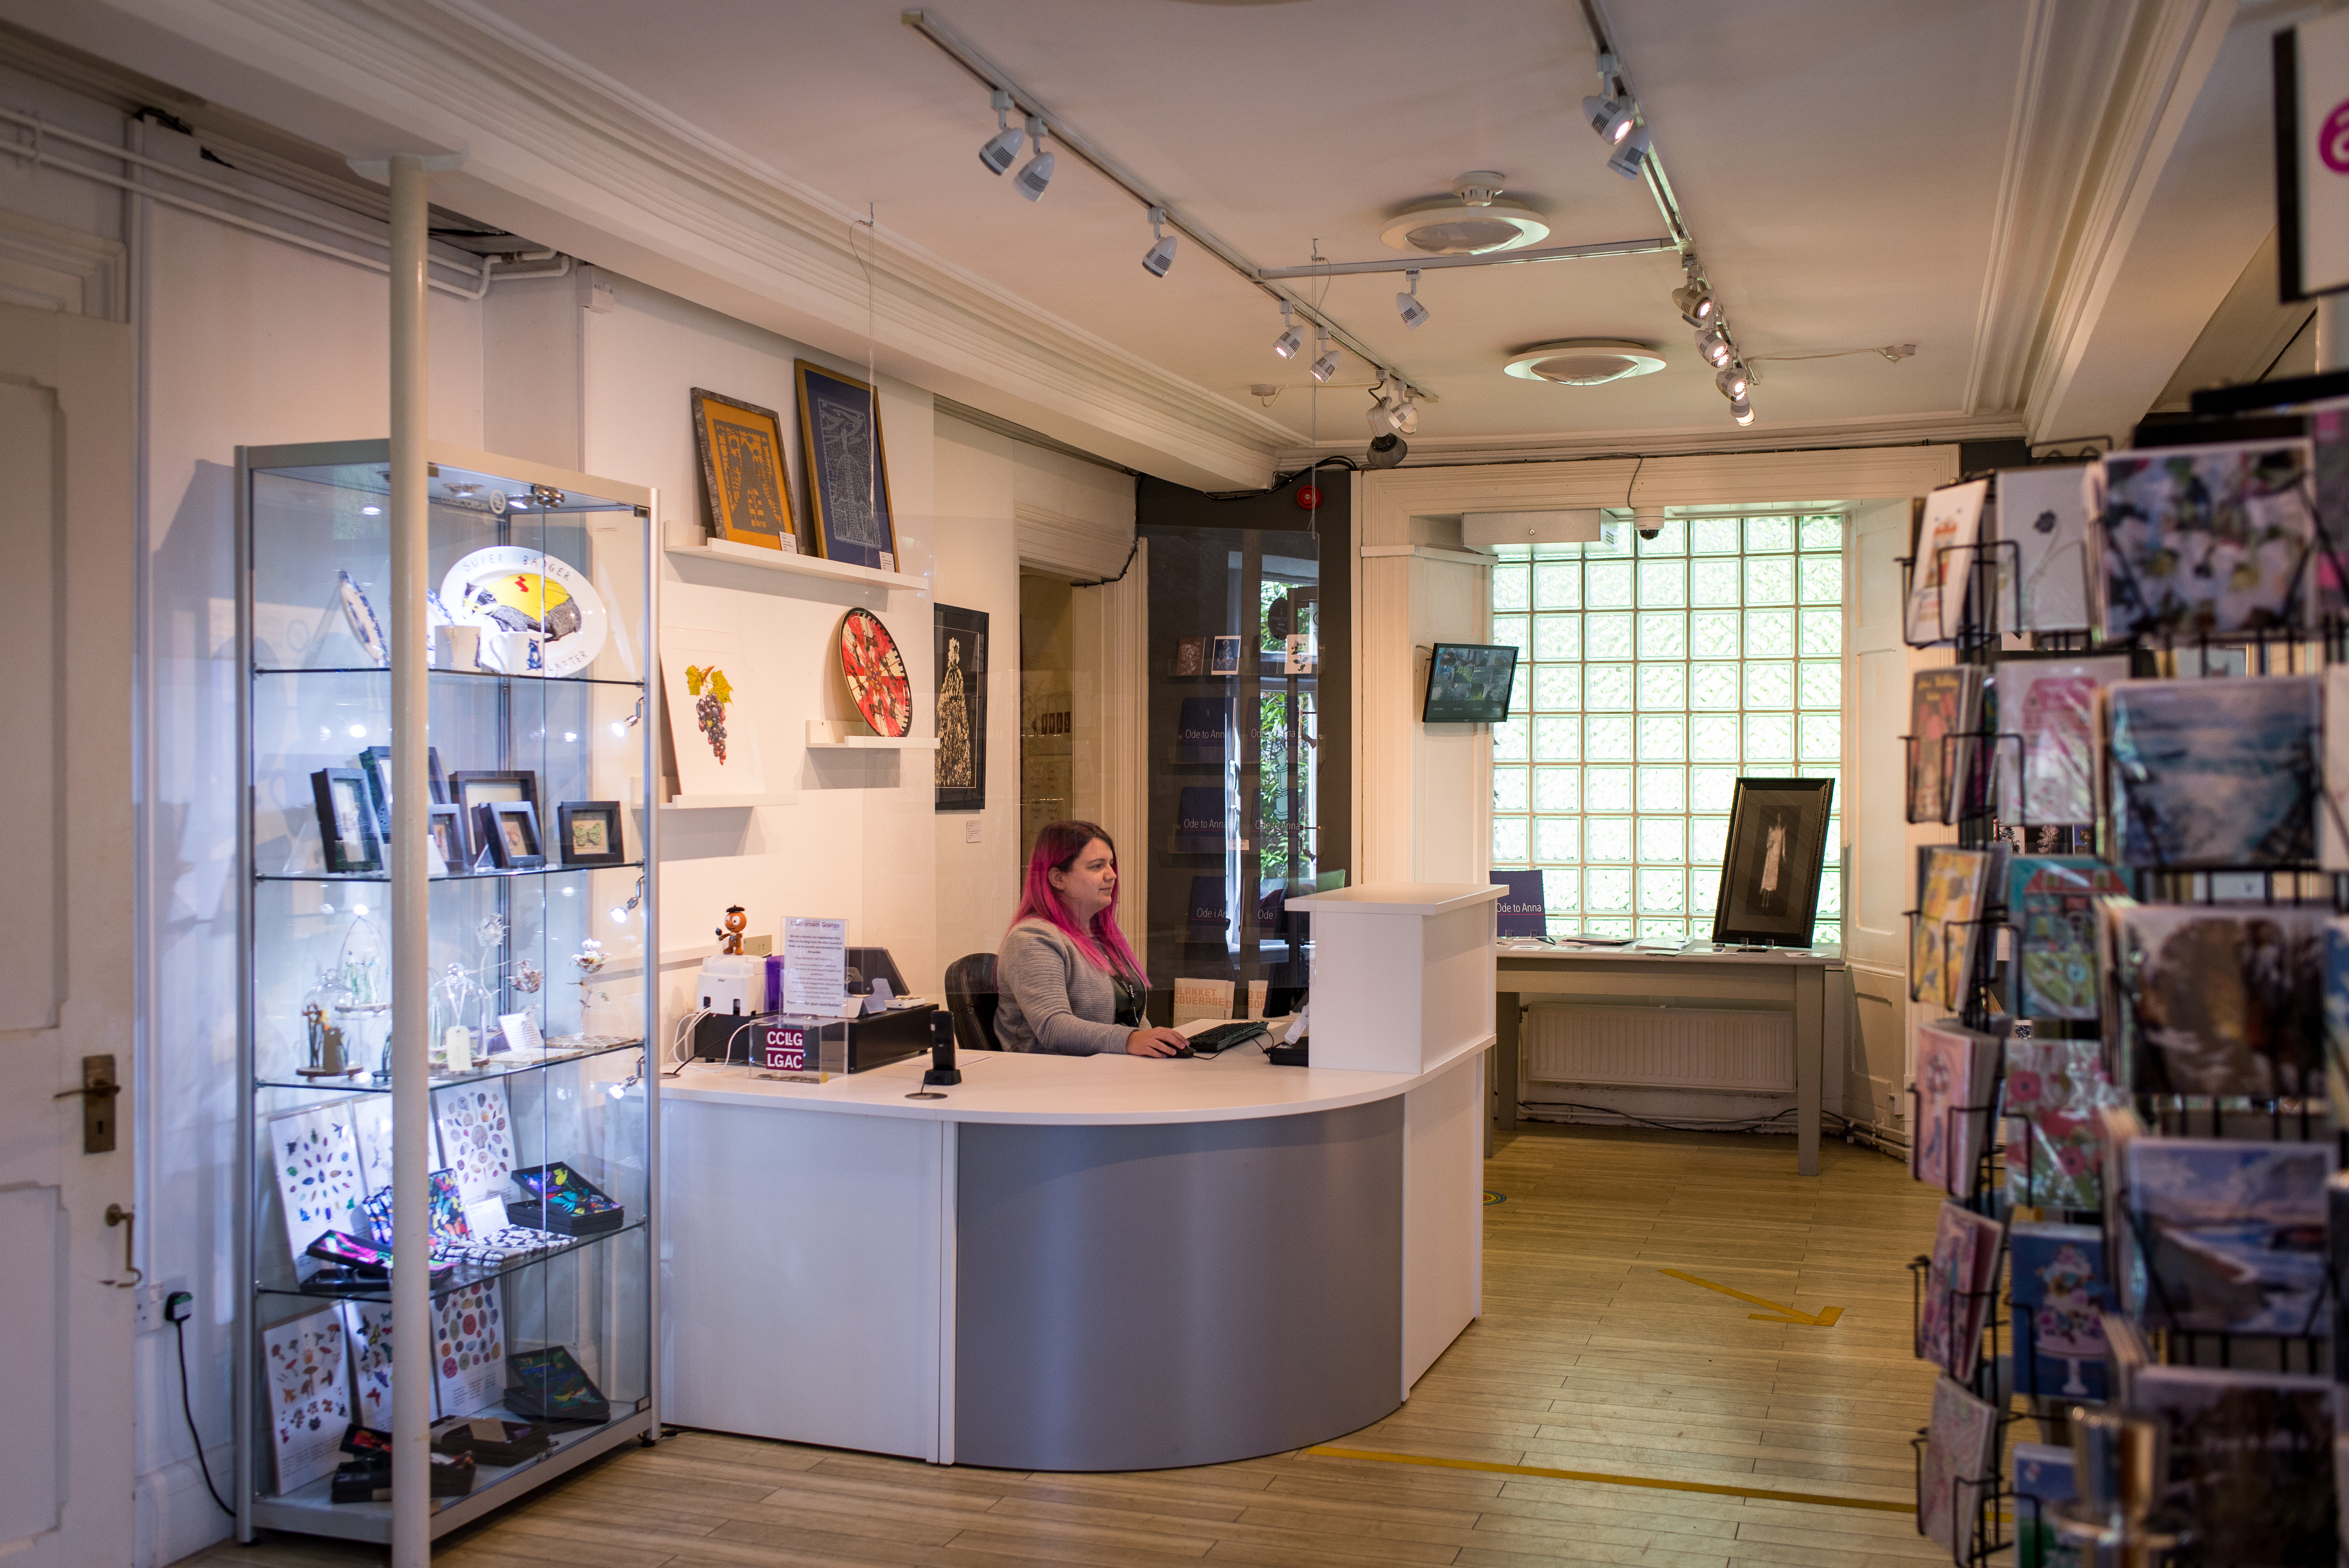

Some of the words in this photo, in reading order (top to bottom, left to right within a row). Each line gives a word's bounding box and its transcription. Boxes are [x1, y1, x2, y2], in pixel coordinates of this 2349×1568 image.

[464, 554, 503, 572] SUPER
[547, 650, 588, 671] LATTER
[1185, 729, 1200, 739] Ode
[1202, 731, 1209, 739] to
[1184, 818, 1199, 828] Ode
[1255, 820, 1271, 830] Ode
[1273, 821, 1280, 830] to
[1281, 821, 1300, 830] Anna
[1496, 902, 1511, 912] Ode
[1513, 904, 1520, 912] to
[1522, 903, 1542, 912] Anna
[1197, 908, 1212, 918] Ode
[1214, 909, 1216, 918] i
[1258, 910, 1273, 919] Ode
[767, 1053, 802, 1069] LGAC
